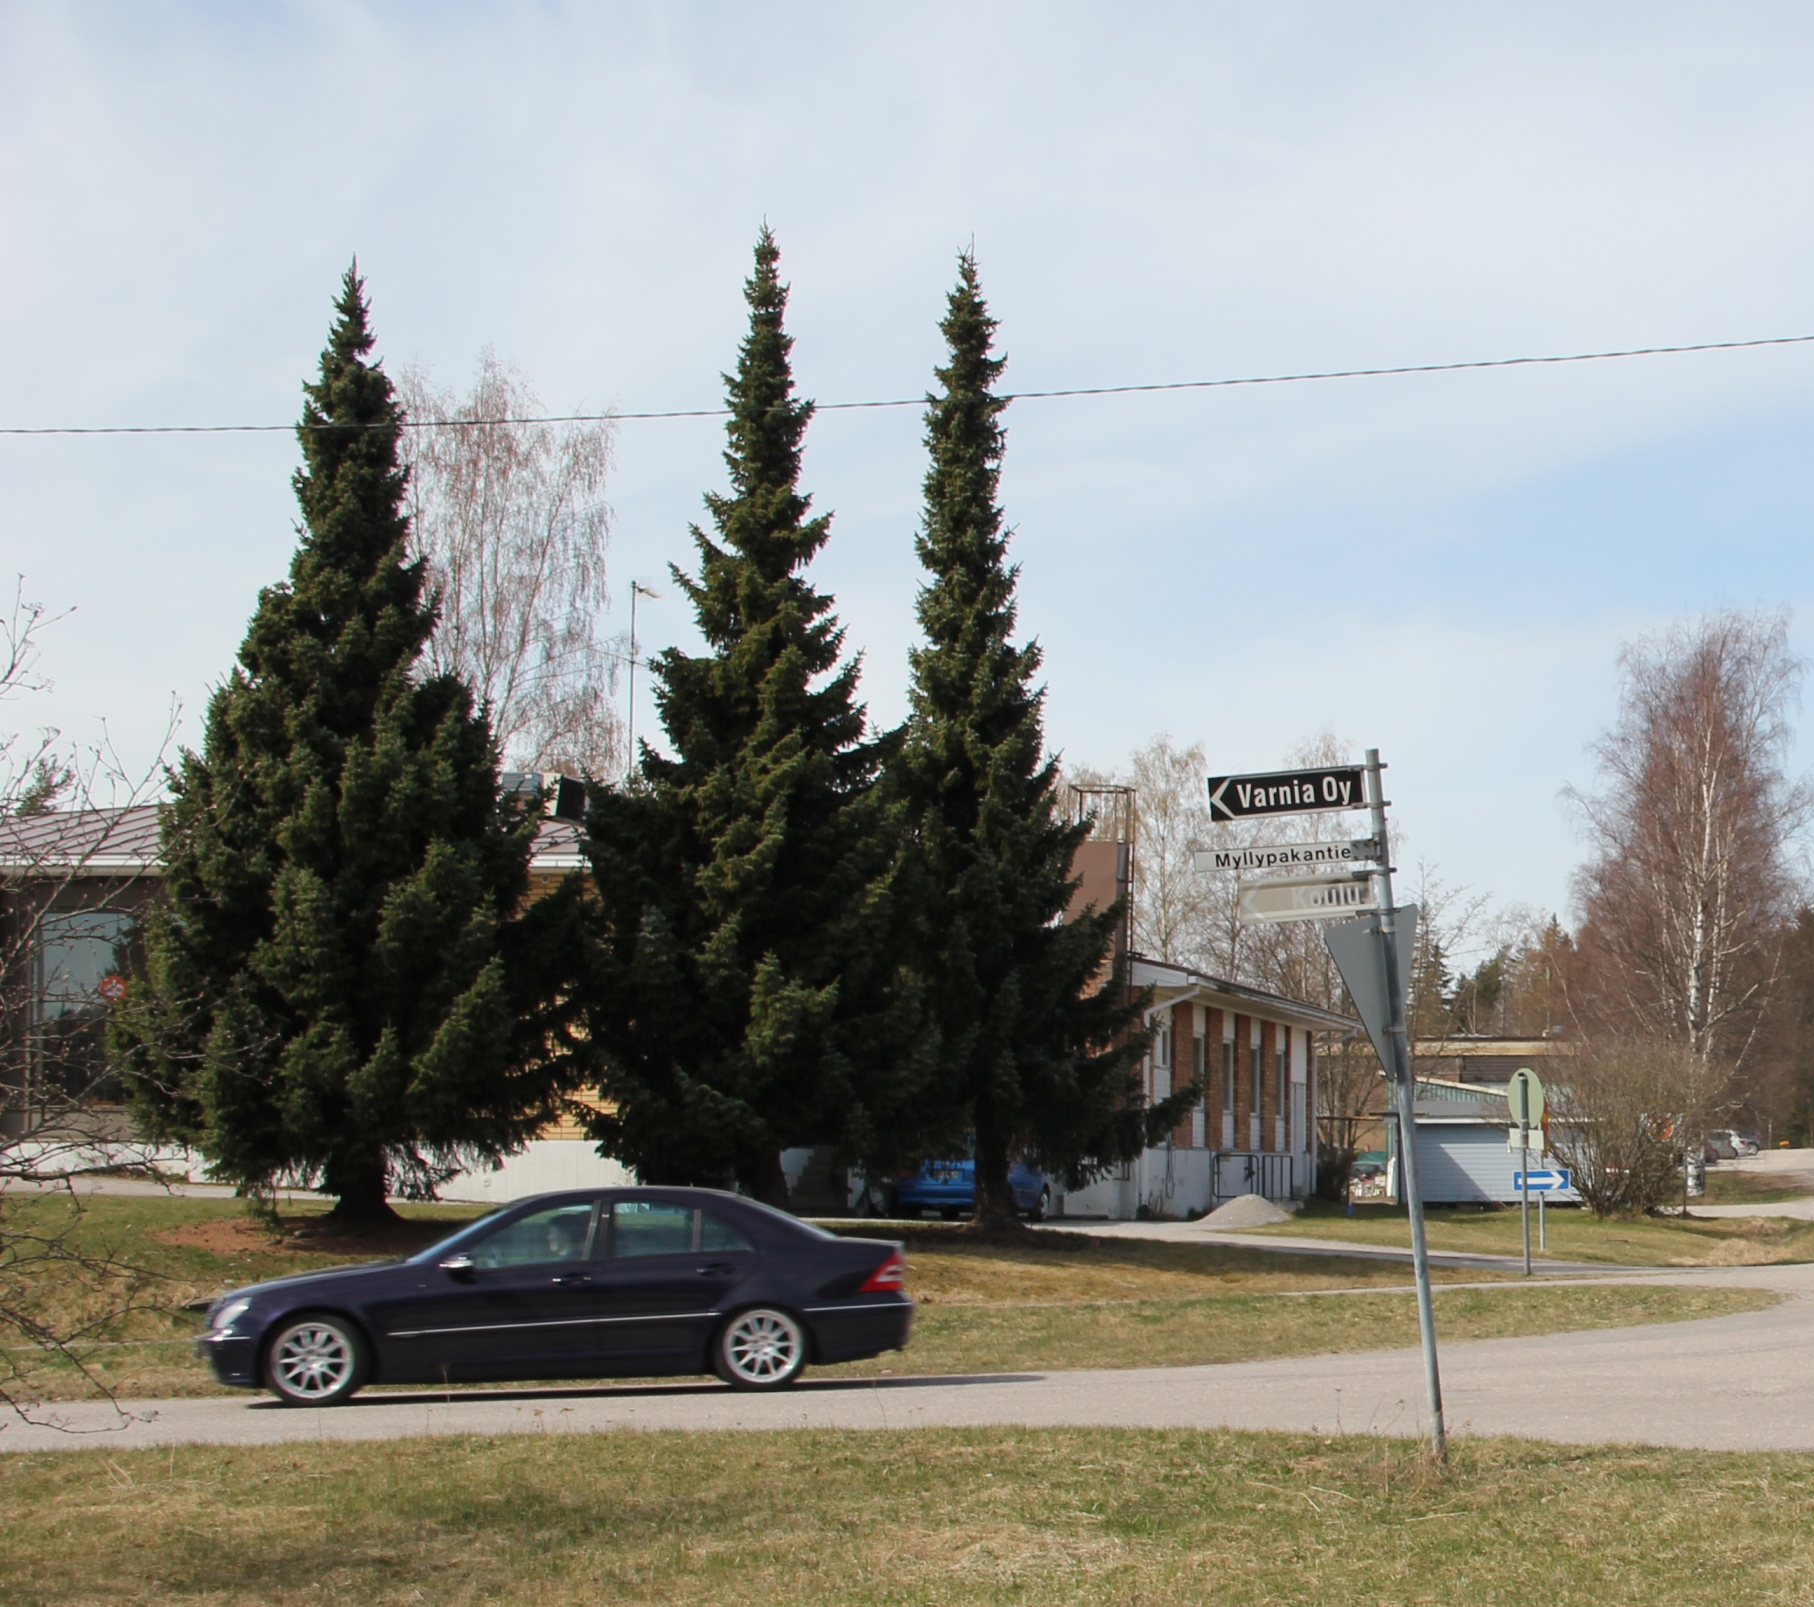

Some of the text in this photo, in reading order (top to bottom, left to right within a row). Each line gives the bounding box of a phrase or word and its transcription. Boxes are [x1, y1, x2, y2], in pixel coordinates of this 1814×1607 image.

[1237, 776, 1352, 808] Varnia Oy
[1215, 845, 1352, 869] Myllypakantie
[1291, 883, 1361, 909] Koulu
